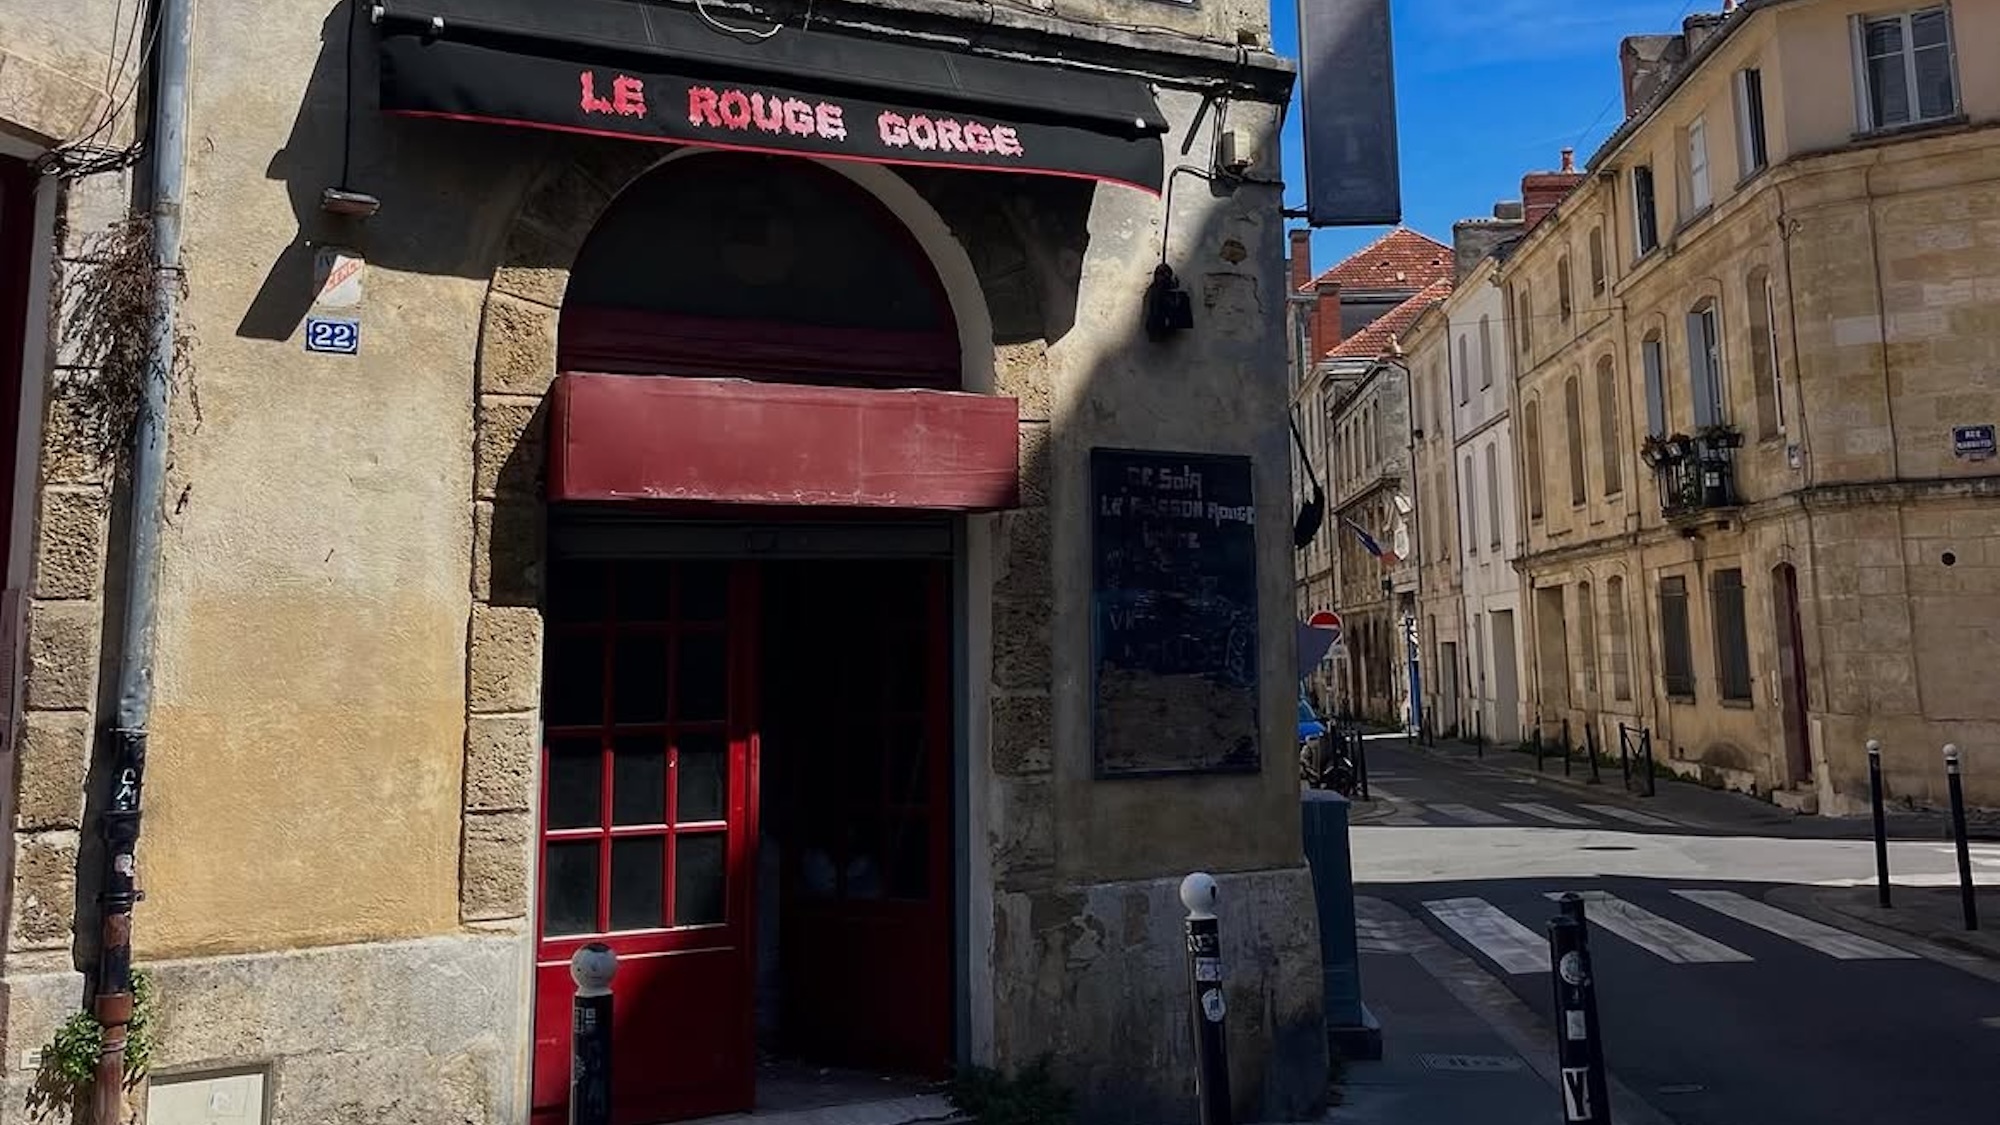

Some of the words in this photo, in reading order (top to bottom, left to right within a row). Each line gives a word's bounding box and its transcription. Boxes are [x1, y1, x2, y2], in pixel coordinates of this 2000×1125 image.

[580, 70, 647, 119] LE
[687, 85, 848, 142] ROUGE
[877, 110, 1024, 158] GORGE
[315, 324, 351, 347] 22
